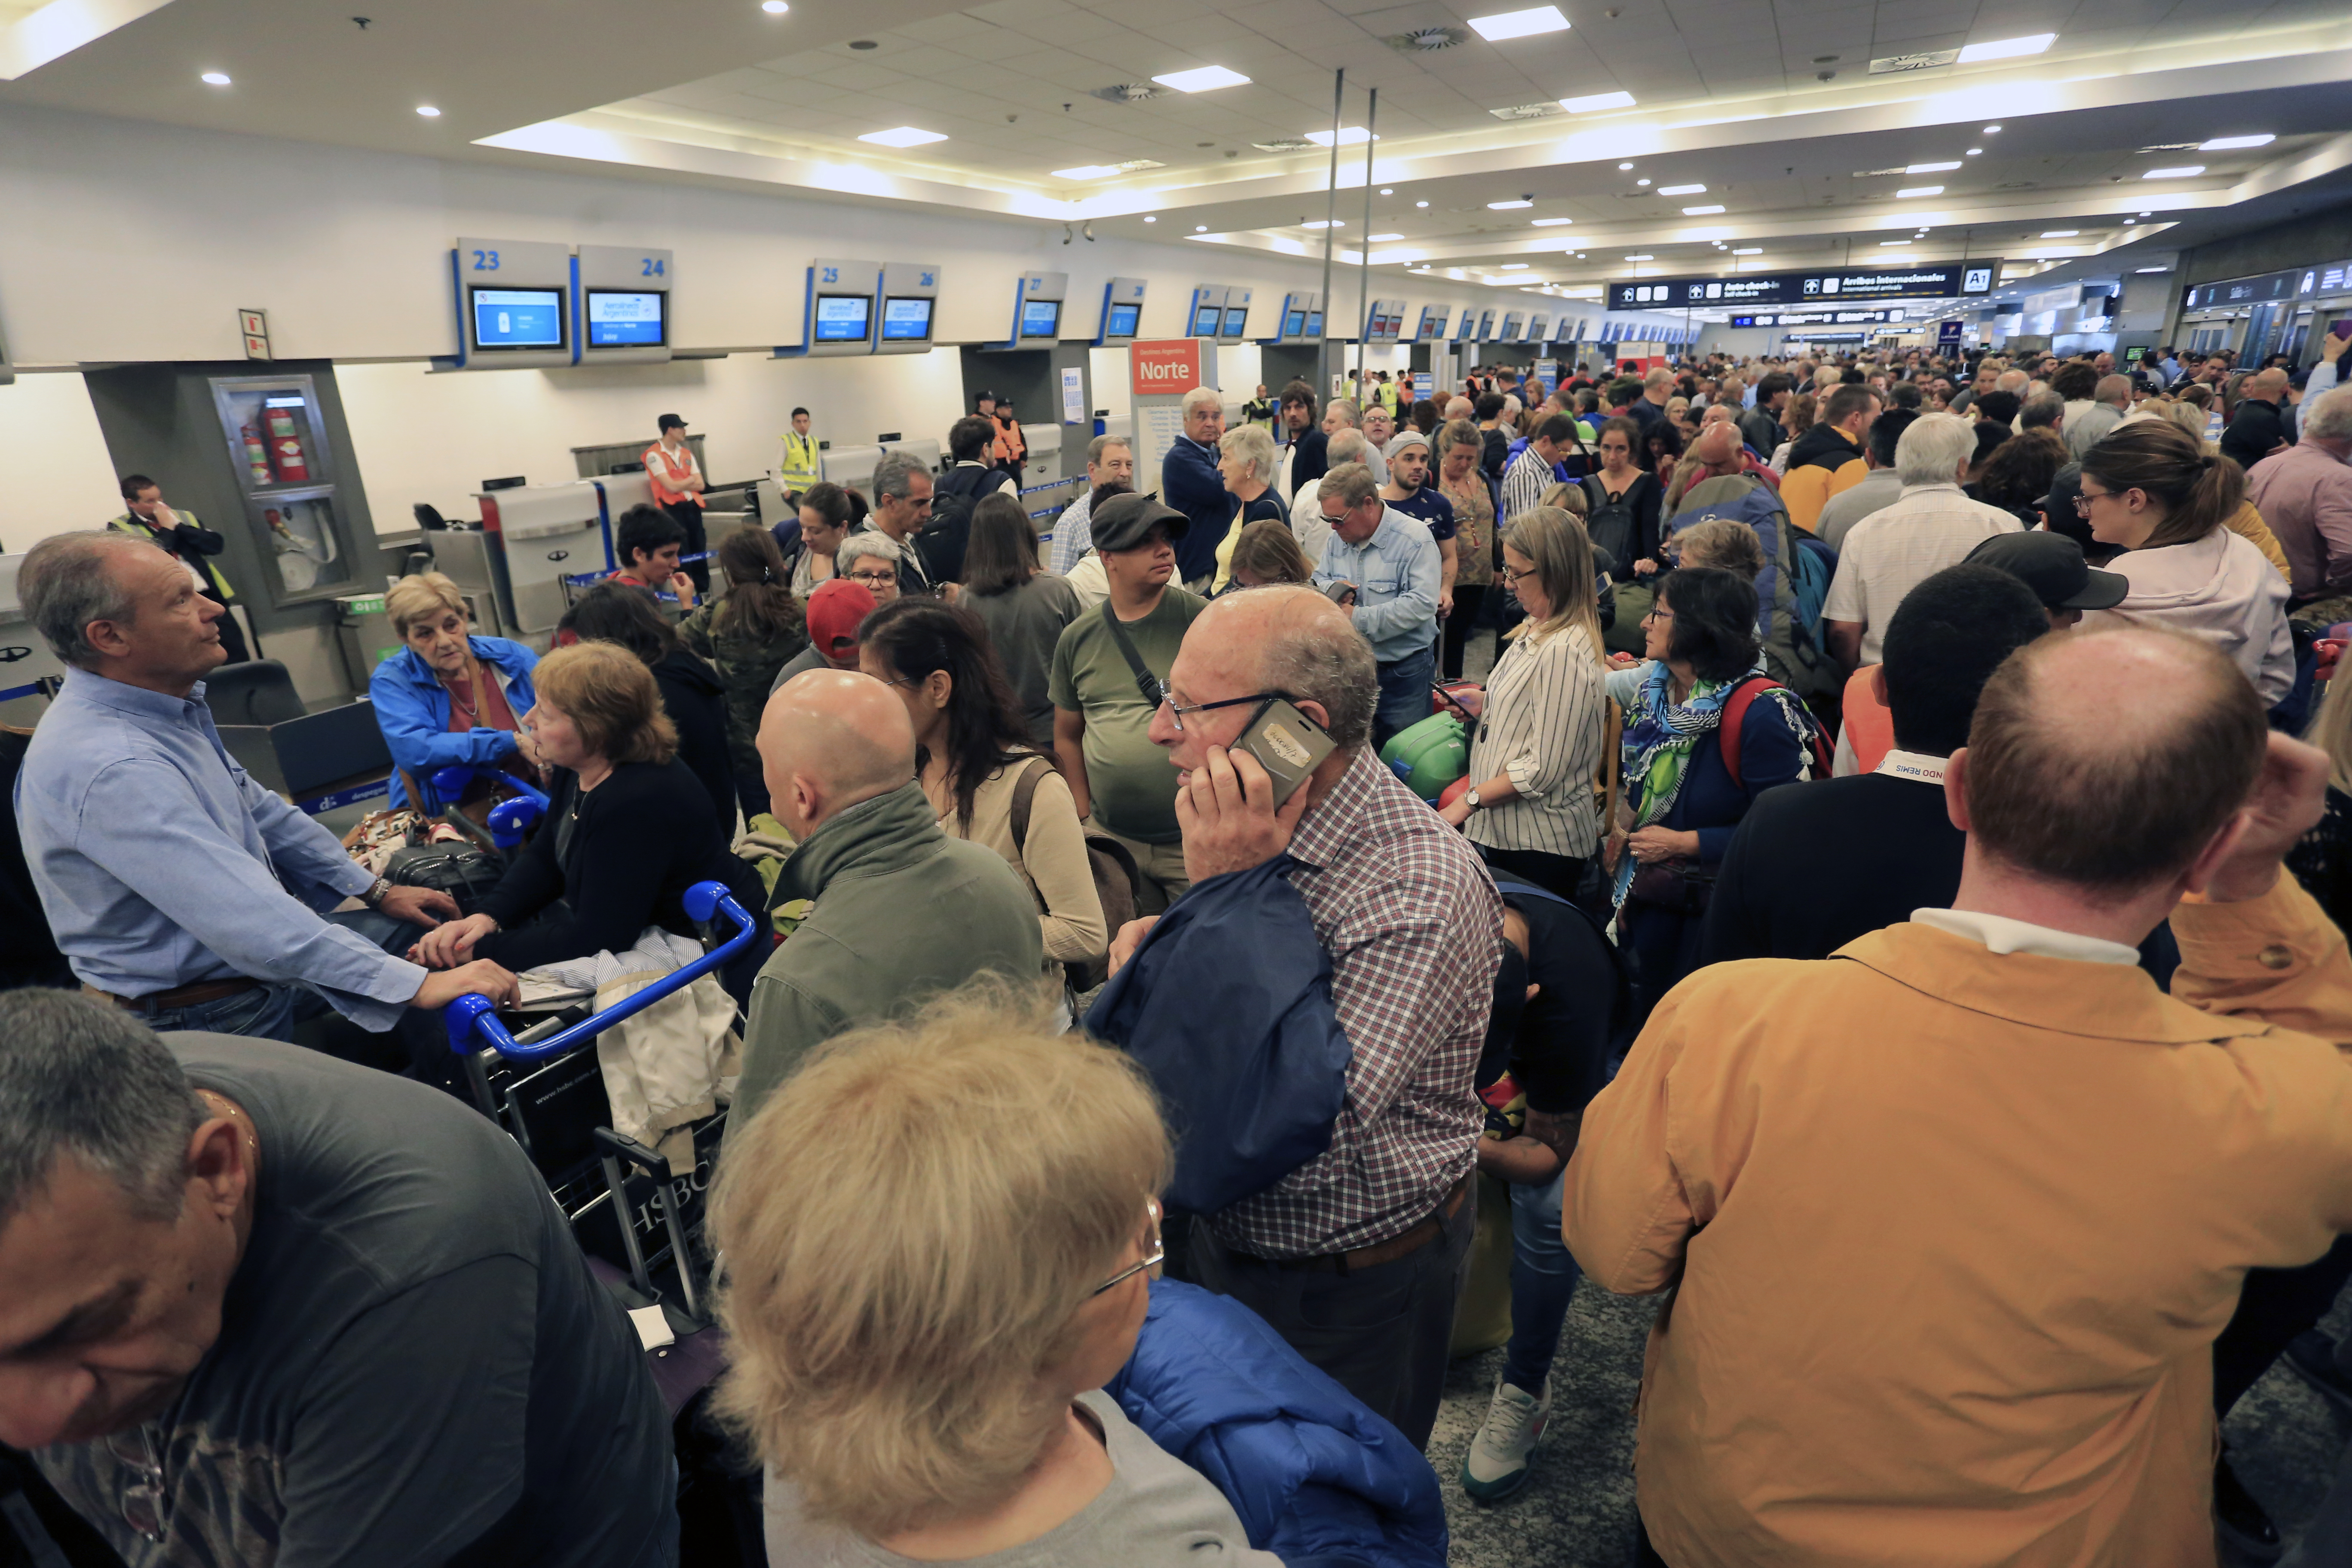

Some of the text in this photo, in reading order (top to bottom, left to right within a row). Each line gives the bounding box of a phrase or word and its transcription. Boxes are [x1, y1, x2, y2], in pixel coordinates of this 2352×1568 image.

[473, 250, 500, 270] 23
[642, 258, 665, 276] 24
[822, 267, 839, 283] 25
[920, 272, 934, 286] 26
[1843, 273, 1946, 285] Arribos internacionales
[1969, 273, 1986, 283] A1
[1030, 278, 1042, 290] 27
[1724, 281, 1780, 291] Auto check-in
[1140, 361, 1190, 380] Norte
[1896, 765, 1943, 779] NDO REMIS
